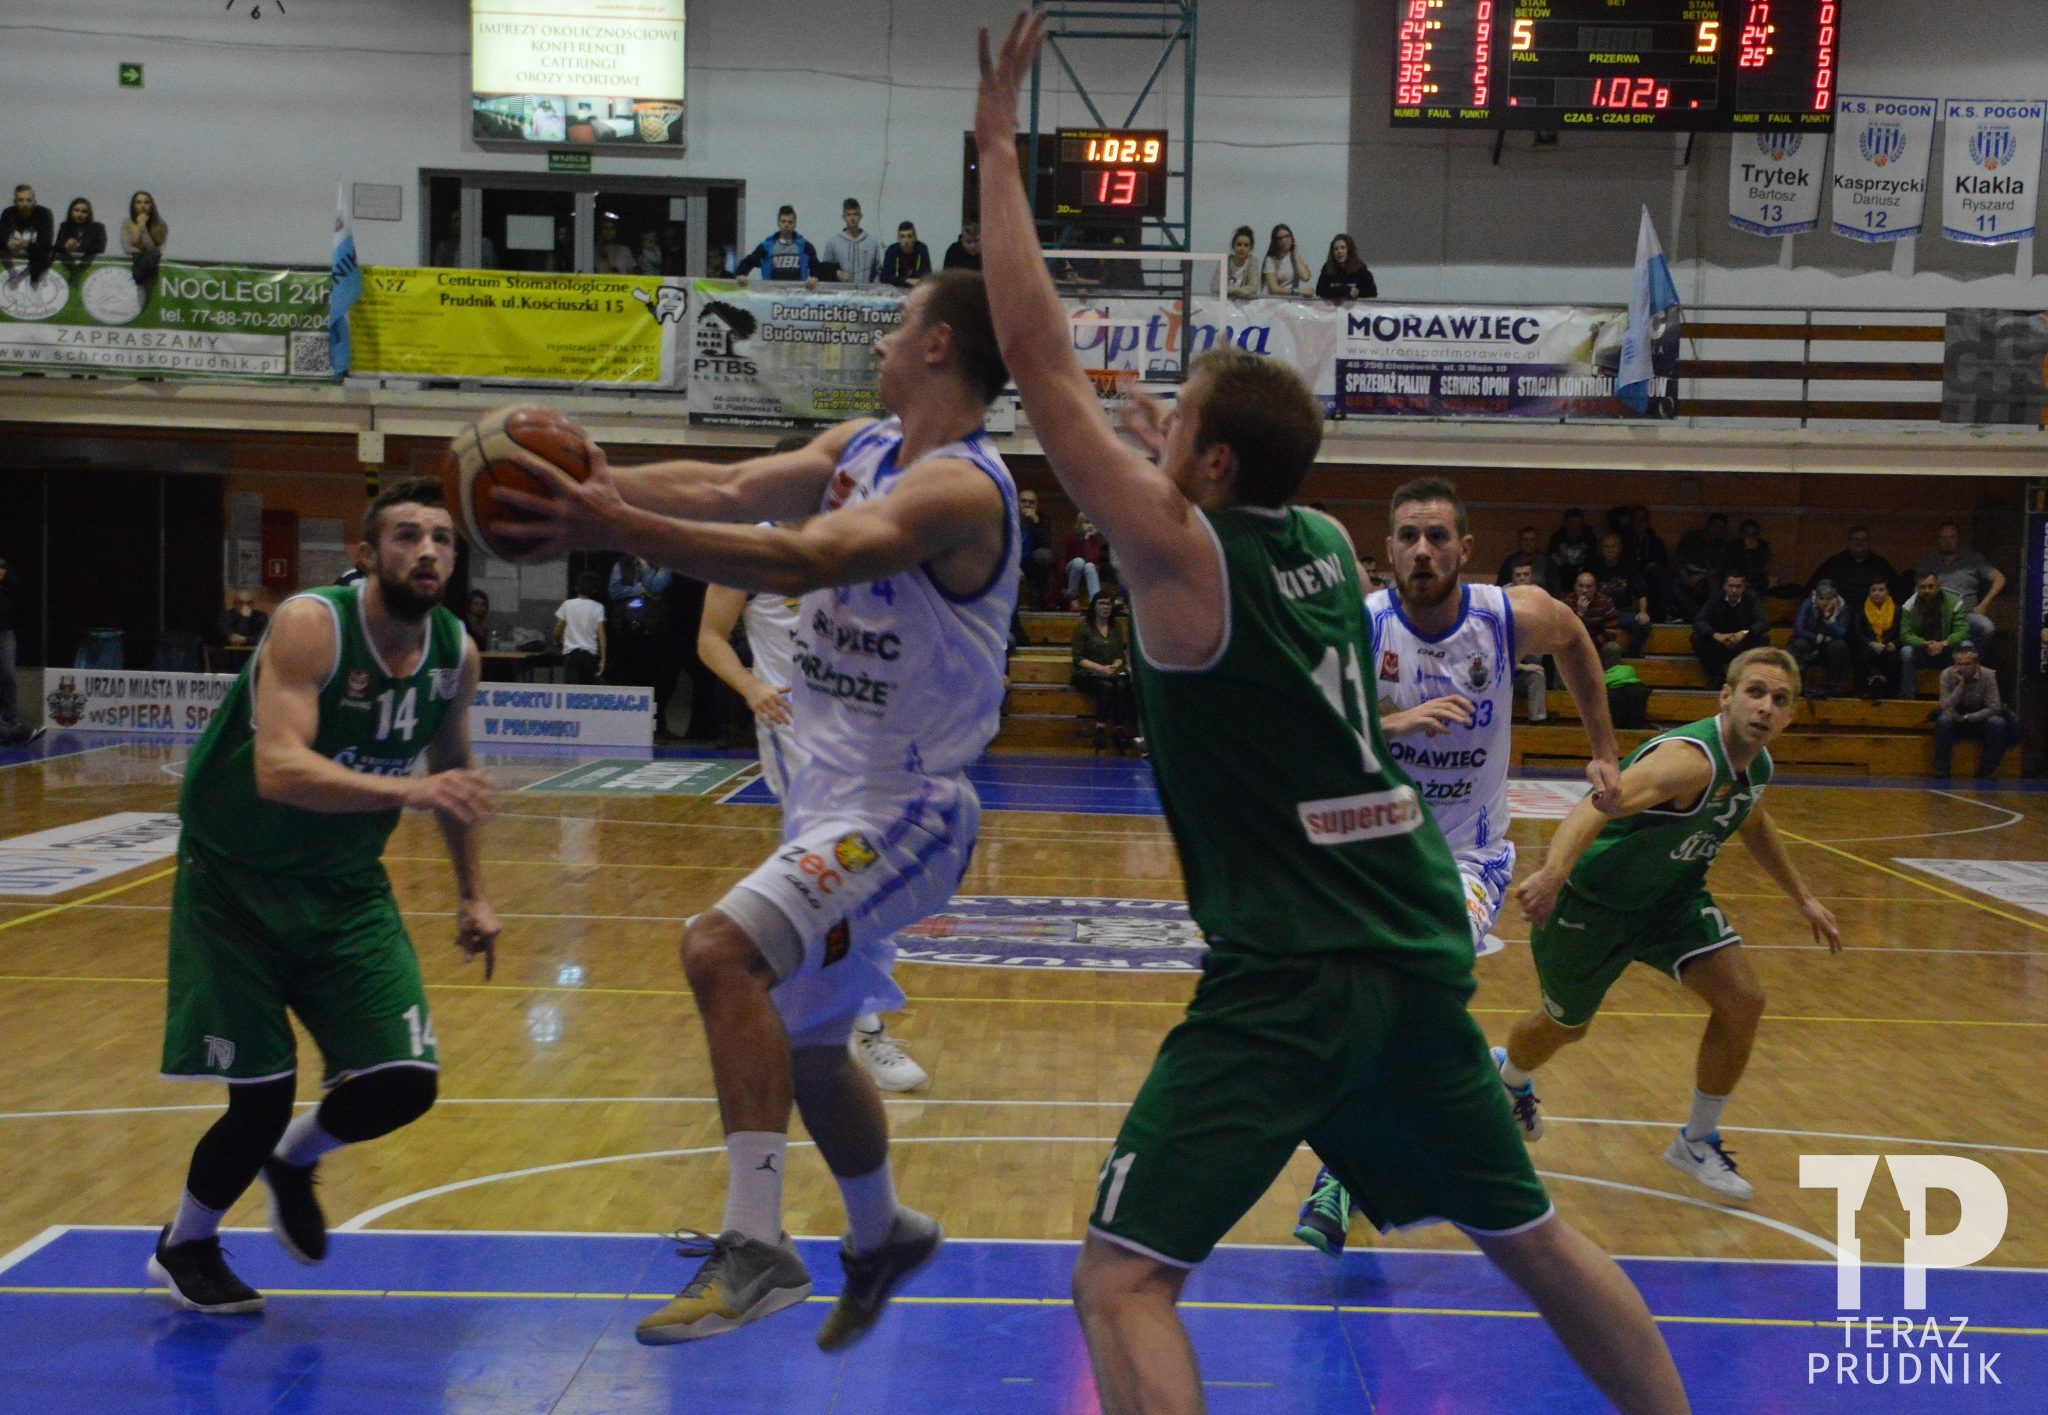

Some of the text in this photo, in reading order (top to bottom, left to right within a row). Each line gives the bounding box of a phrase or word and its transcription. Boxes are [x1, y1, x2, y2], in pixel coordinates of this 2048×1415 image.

[251, 5, 261, 20] 6
[1750, 4, 1834, 24] 17 0
[479, 23, 537, 37] IMPREZY
[1401, 21, 1490, 42] 24 9
[1511, 19, 1534, 51] 5
[1697, 21, 1719, 52] 5
[1742, 26, 1833, 46] 24 0
[531, 40, 627, 55] KONFERENCJE
[1400, 42, 1489, 63] 33 5
[1512, 52, 1538, 62] FAUL
[541, 57, 616, 70] CATERINGI
[1589, 53, 1641, 64] PRZERWA
[1689, 56, 1716, 65] FAUL
[1740, 48, 1832, 67] 25 5
[516, 71, 642, 87] OBOZY SPORTOWE
[1399, 63, 1488, 85] 35 2
[1816, 69, 1830, 89] 0
[1398, 85, 1487, 106] 55 3
[1815, 91, 1829, 110] 0
[1394, 109, 1489, 119] NUMER FAUL PUNKTY
[1841, 101, 1870, 114] K.S.
[1950, 107, 1978, 118] K.S.
[1563, 113, 1656, 124] CZAS CZAS GRY
[1733, 114, 1830, 124] NUMER FAUL PUNKTY
[1741, 164, 1810, 188] Trytek
[1834, 174, 1925, 194] Kasprzycki
[1955, 175, 2024, 196] Klakla
[1098, 170, 1137, 204] 13
[1749, 187, 1796, 202] Bartosz
[1853, 193, 1901, 207] Dariusz
[1962, 198, 2015, 212] Ryszard
[1760, 204, 1783, 222] 13
[1864, 211, 1888, 228] 12
[1976, 214, 1997, 231] 11
[160, 276, 281, 303] NOCLEGI
[288, 283, 331, 305] 24h
[438, 272, 630, 295] Centrum Stomatologiczne
[440, 293, 496, 309] Prudnik
[605, 300, 624, 313] 15
[160, 307, 186, 323] tel.
[772, 304, 903, 324] Prudnickie Towa
[762, 325, 868, 345] Budownictwa
[1347, 313, 1541, 345] MORAWIEC
[57, 328, 220, 351] ZAPRASZAMY
[1346, 346, 1541, 362] www.transportmorawiec.pl
[694, 359, 757, 376] PTBS
[1399, 375, 1432, 394] PALIW
[1440, 375, 1480, 396] SERWIS
[1481, 377, 1510, 396] OPON
[1517, 376, 1557, 397] STACJA
[1559, 376, 1613, 397] KONTROLI
[129, 678, 173, 700] MIASTA
[176, 680, 188, 699] W
[493, 690, 553, 709] SPORTU
[556, 693, 563, 709] I
[375, 687, 420, 741] 14
[485, 718, 500, 735] W
[1387, 741, 1488, 769] ORAWIEC
